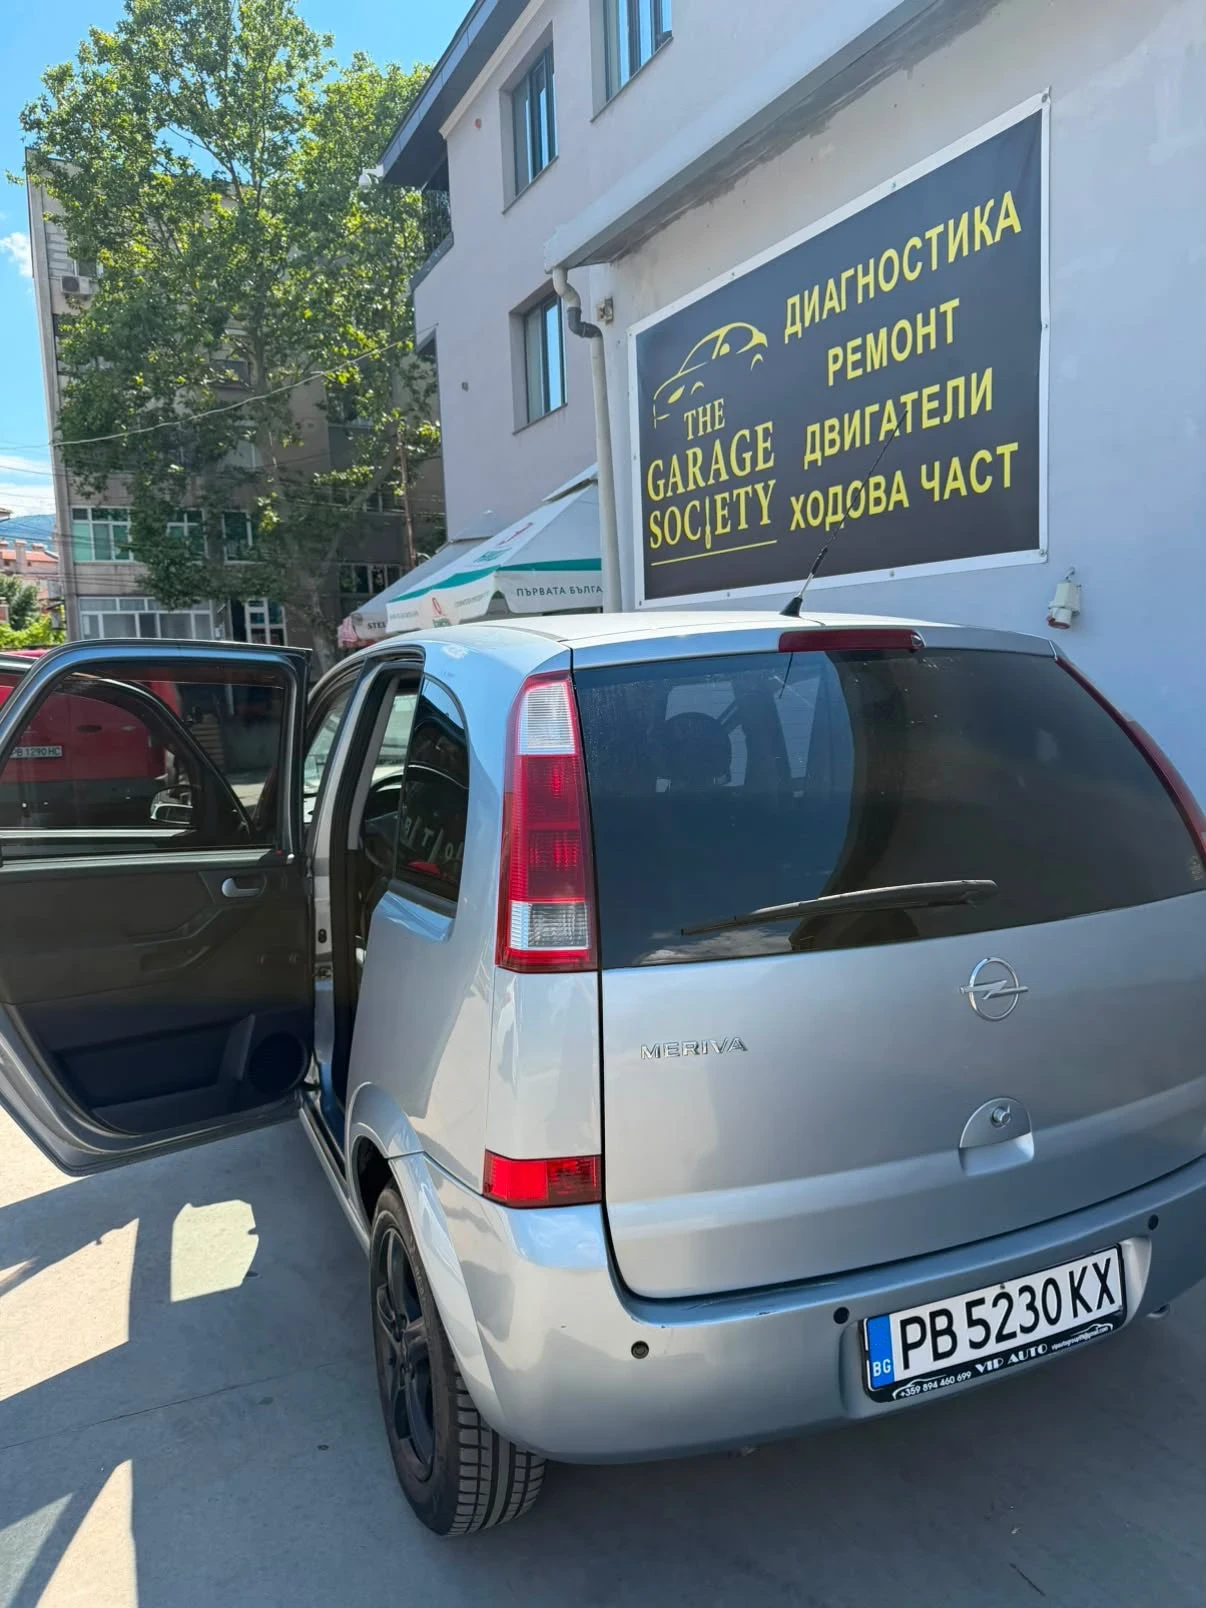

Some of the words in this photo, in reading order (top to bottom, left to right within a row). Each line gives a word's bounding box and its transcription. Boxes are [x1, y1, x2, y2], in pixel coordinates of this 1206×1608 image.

[784, 191, 1022, 344] ДИАГНОСТИКА
[828, 298, 960, 386] РЕМОНТ
[684, 398, 725, 440] THE
[804, 368, 993, 469] ДВИГАТЕЛИ
[647, 420, 775, 501] GARAGE
[789, 470, 910, 531] ХОДОВА
[920, 442, 1019, 502] ЧАСТ
[649, 479, 777, 549] SOCIETY
[516, 586, 567, 597] ПЪРВАТА
[641, 1037, 748, 1059] MERIVA
[900, 1308, 957, 1371] PB
[965, 1277, 1062, 1350] 5230
[1069, 1258, 1116, 1319] KX
[873, 1359, 891, 1377] BG
[900, 1385, 921, 1398] +359
[922, 1381, 938, 1392] 894
[974, 1358, 1004, 1374] VIP
[1007, 1343, 1048, 1365] AUTO
